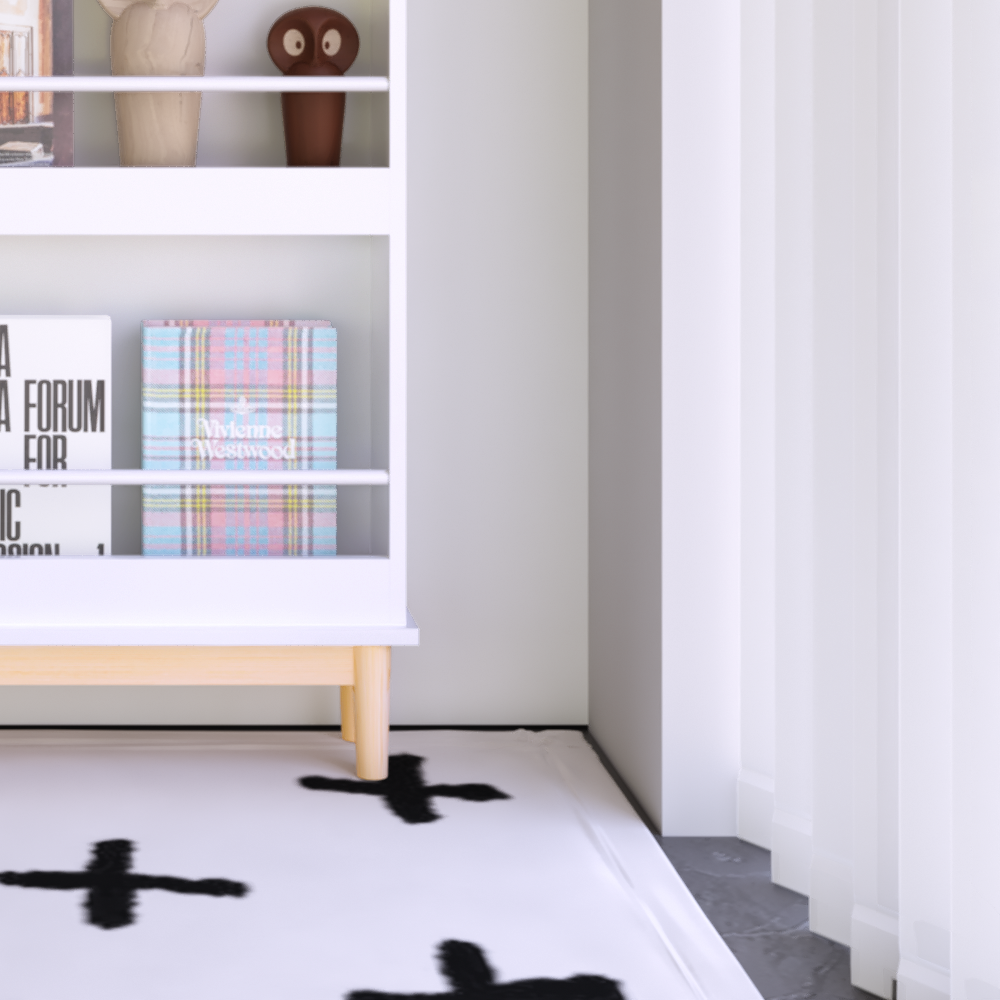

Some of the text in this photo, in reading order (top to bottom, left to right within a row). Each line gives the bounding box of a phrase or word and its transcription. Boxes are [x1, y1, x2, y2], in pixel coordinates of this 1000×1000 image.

[24, 380, 105, 432] FORUM
[198, 418, 282, 439] Vivienne
[193, 438, 296, 460] Westwood
